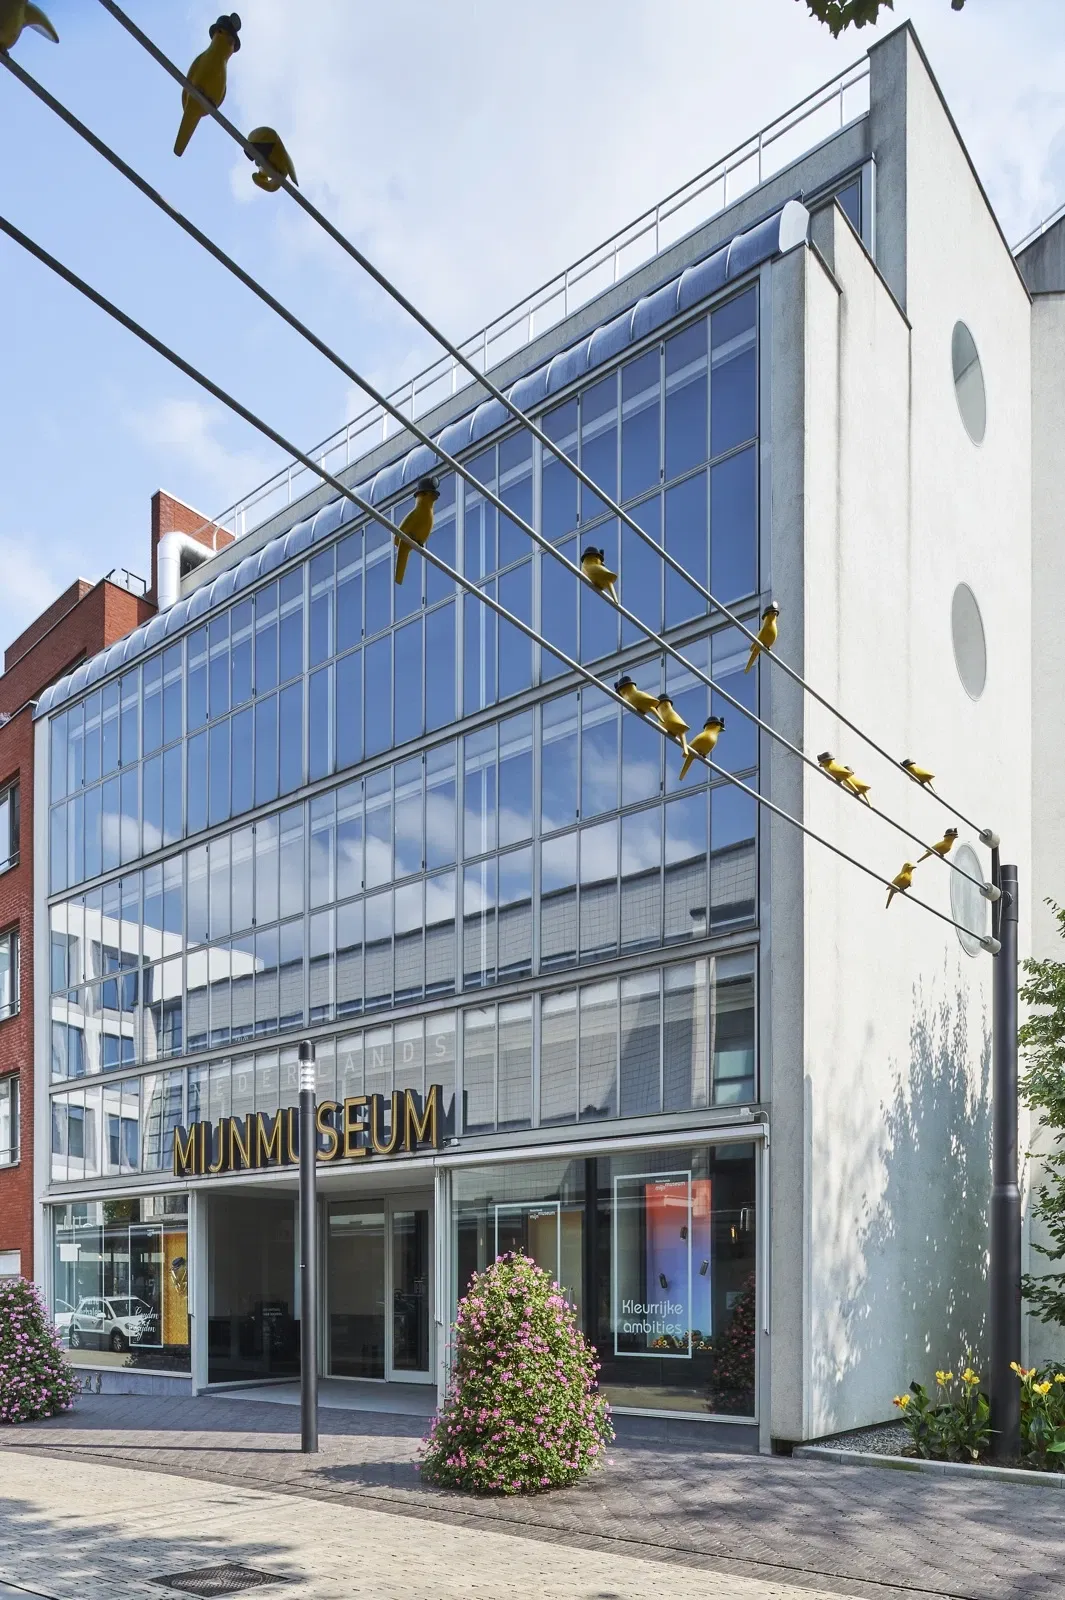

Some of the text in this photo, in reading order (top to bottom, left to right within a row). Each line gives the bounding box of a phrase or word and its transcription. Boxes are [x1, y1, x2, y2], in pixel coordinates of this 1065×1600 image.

[173, 1084, 443, 1177] MIJNMUSEUM
[622, 1299, 684, 1318] Kleurrijke
[623, 1319, 682, 1334] ambities
